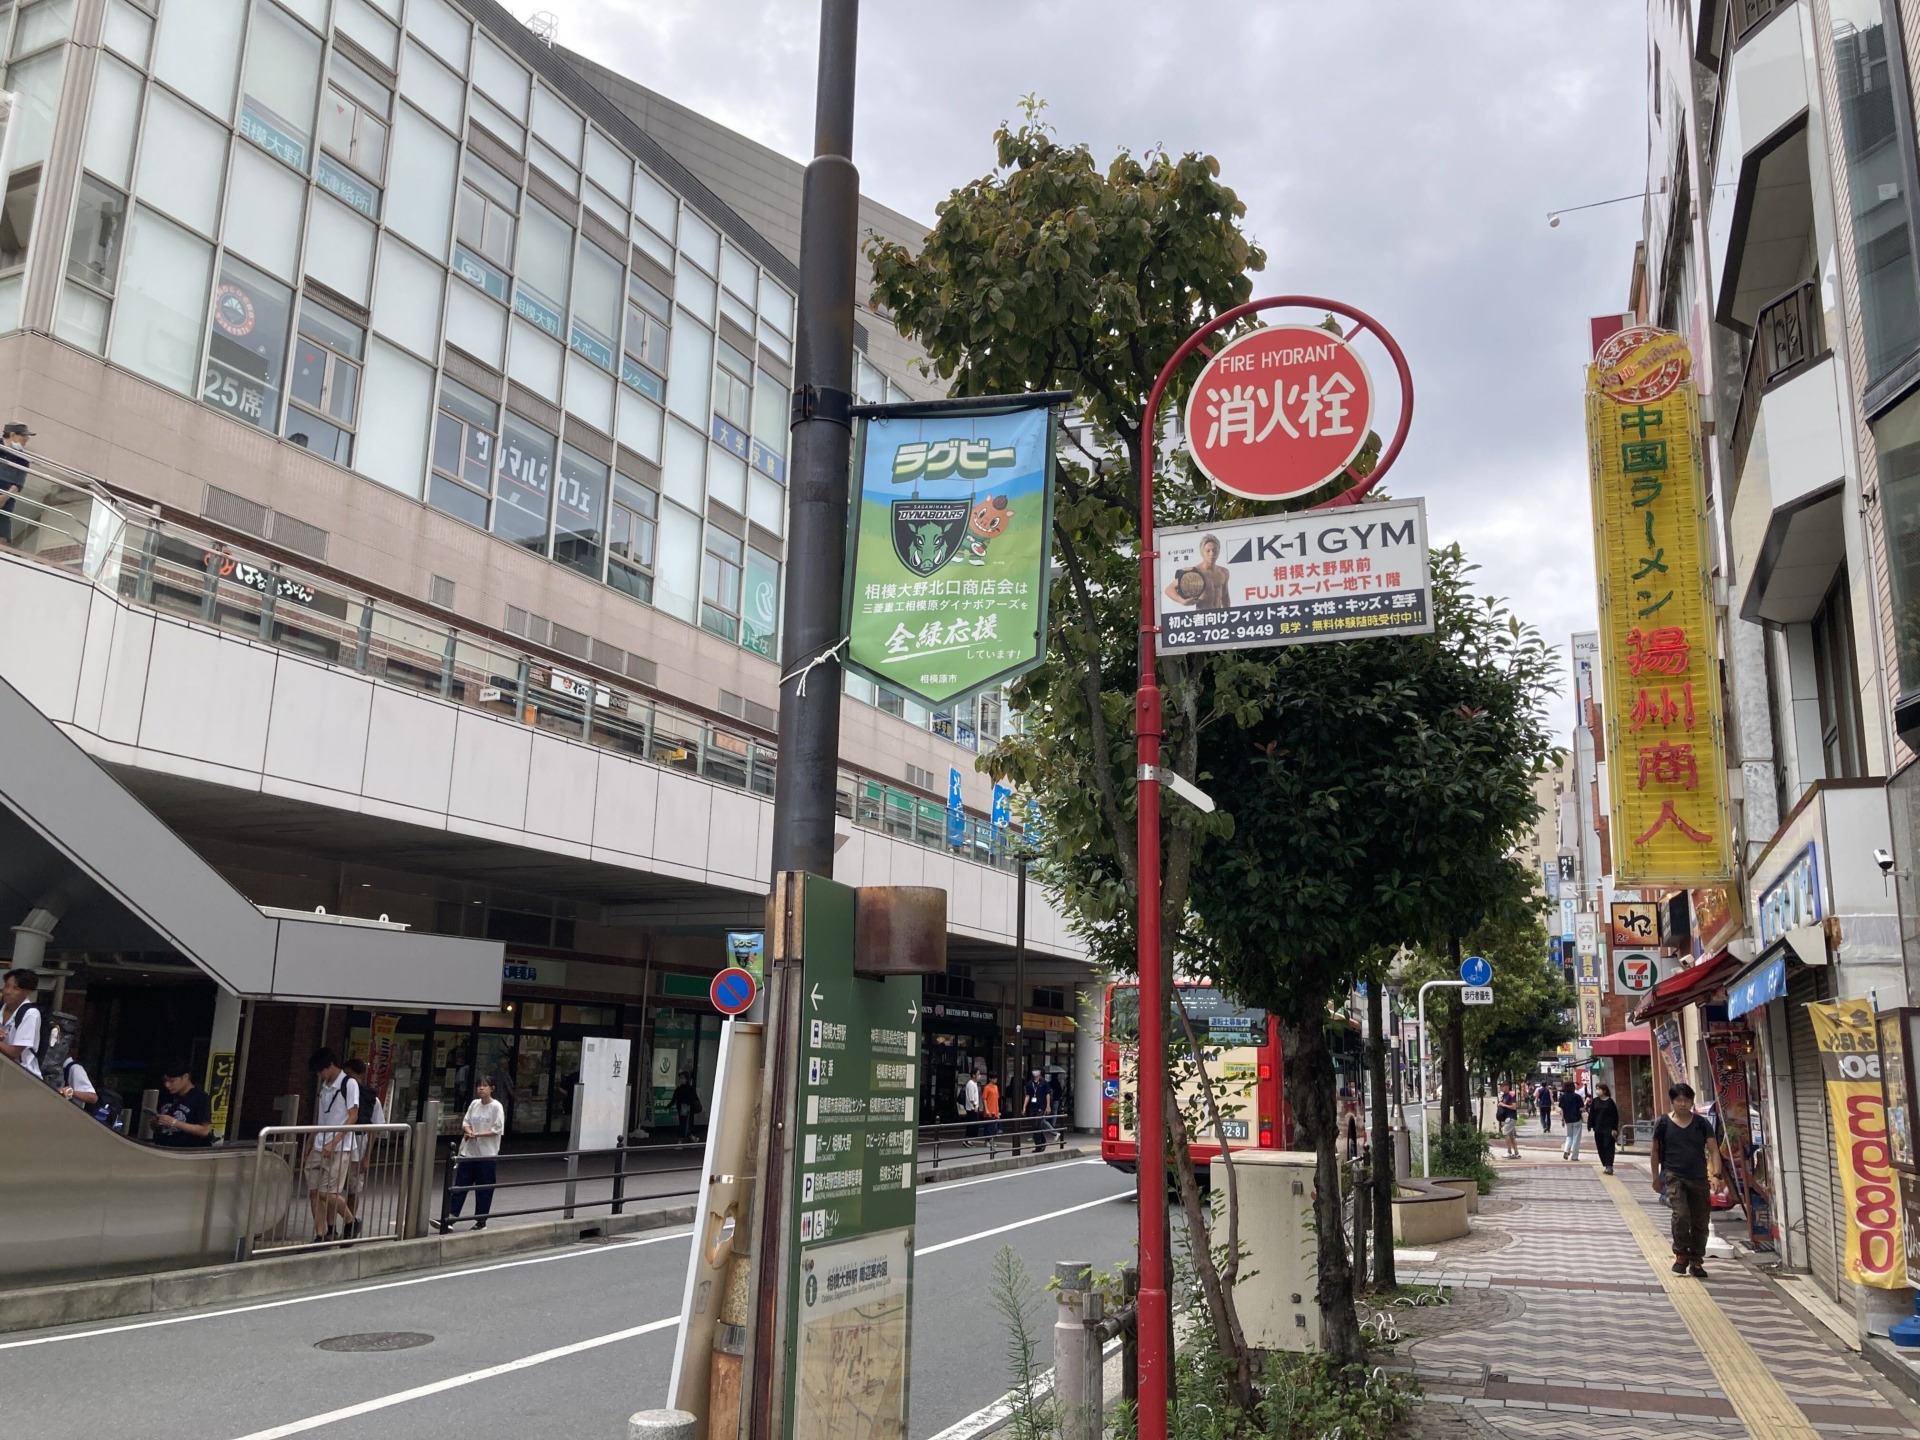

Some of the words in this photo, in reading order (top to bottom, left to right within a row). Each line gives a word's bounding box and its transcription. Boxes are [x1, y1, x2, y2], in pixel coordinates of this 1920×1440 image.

[1219, 352, 1255, 375] FIRE
[1261, 343, 1339, 369] HYDRANT
[204, 368, 264, 418] 25席
[1206, 371, 1356, 450] 消火栓
[893, 438, 1016, 482] ラグビー
[898, 508, 966, 520] DYNABOARS
[1258, 531, 1307, 561] K-1
[1317, 520, 1416, 554] GYM
[1273, 557, 1372, 581] 相模大野駅前
[864, 578, 1028, 601] 相模大野北口商店会は
[862, 598, 1028, 614] 三菱重工相模原ダイナボアーズを
[1168, 593, 1418, 630] 初心者向けフィットネス・女性・キッズ・空手
[884, 612, 999, 654] 全緑応援
[1168, 623, 1275, 645] 042-702-9449
[920, 674, 957, 684] 相模原市
[1627, 963, 1648, 988] 7
[1464, 990, 1490, 1001] 歩行者優先
[821, 1059, 834, 1077] 交番
